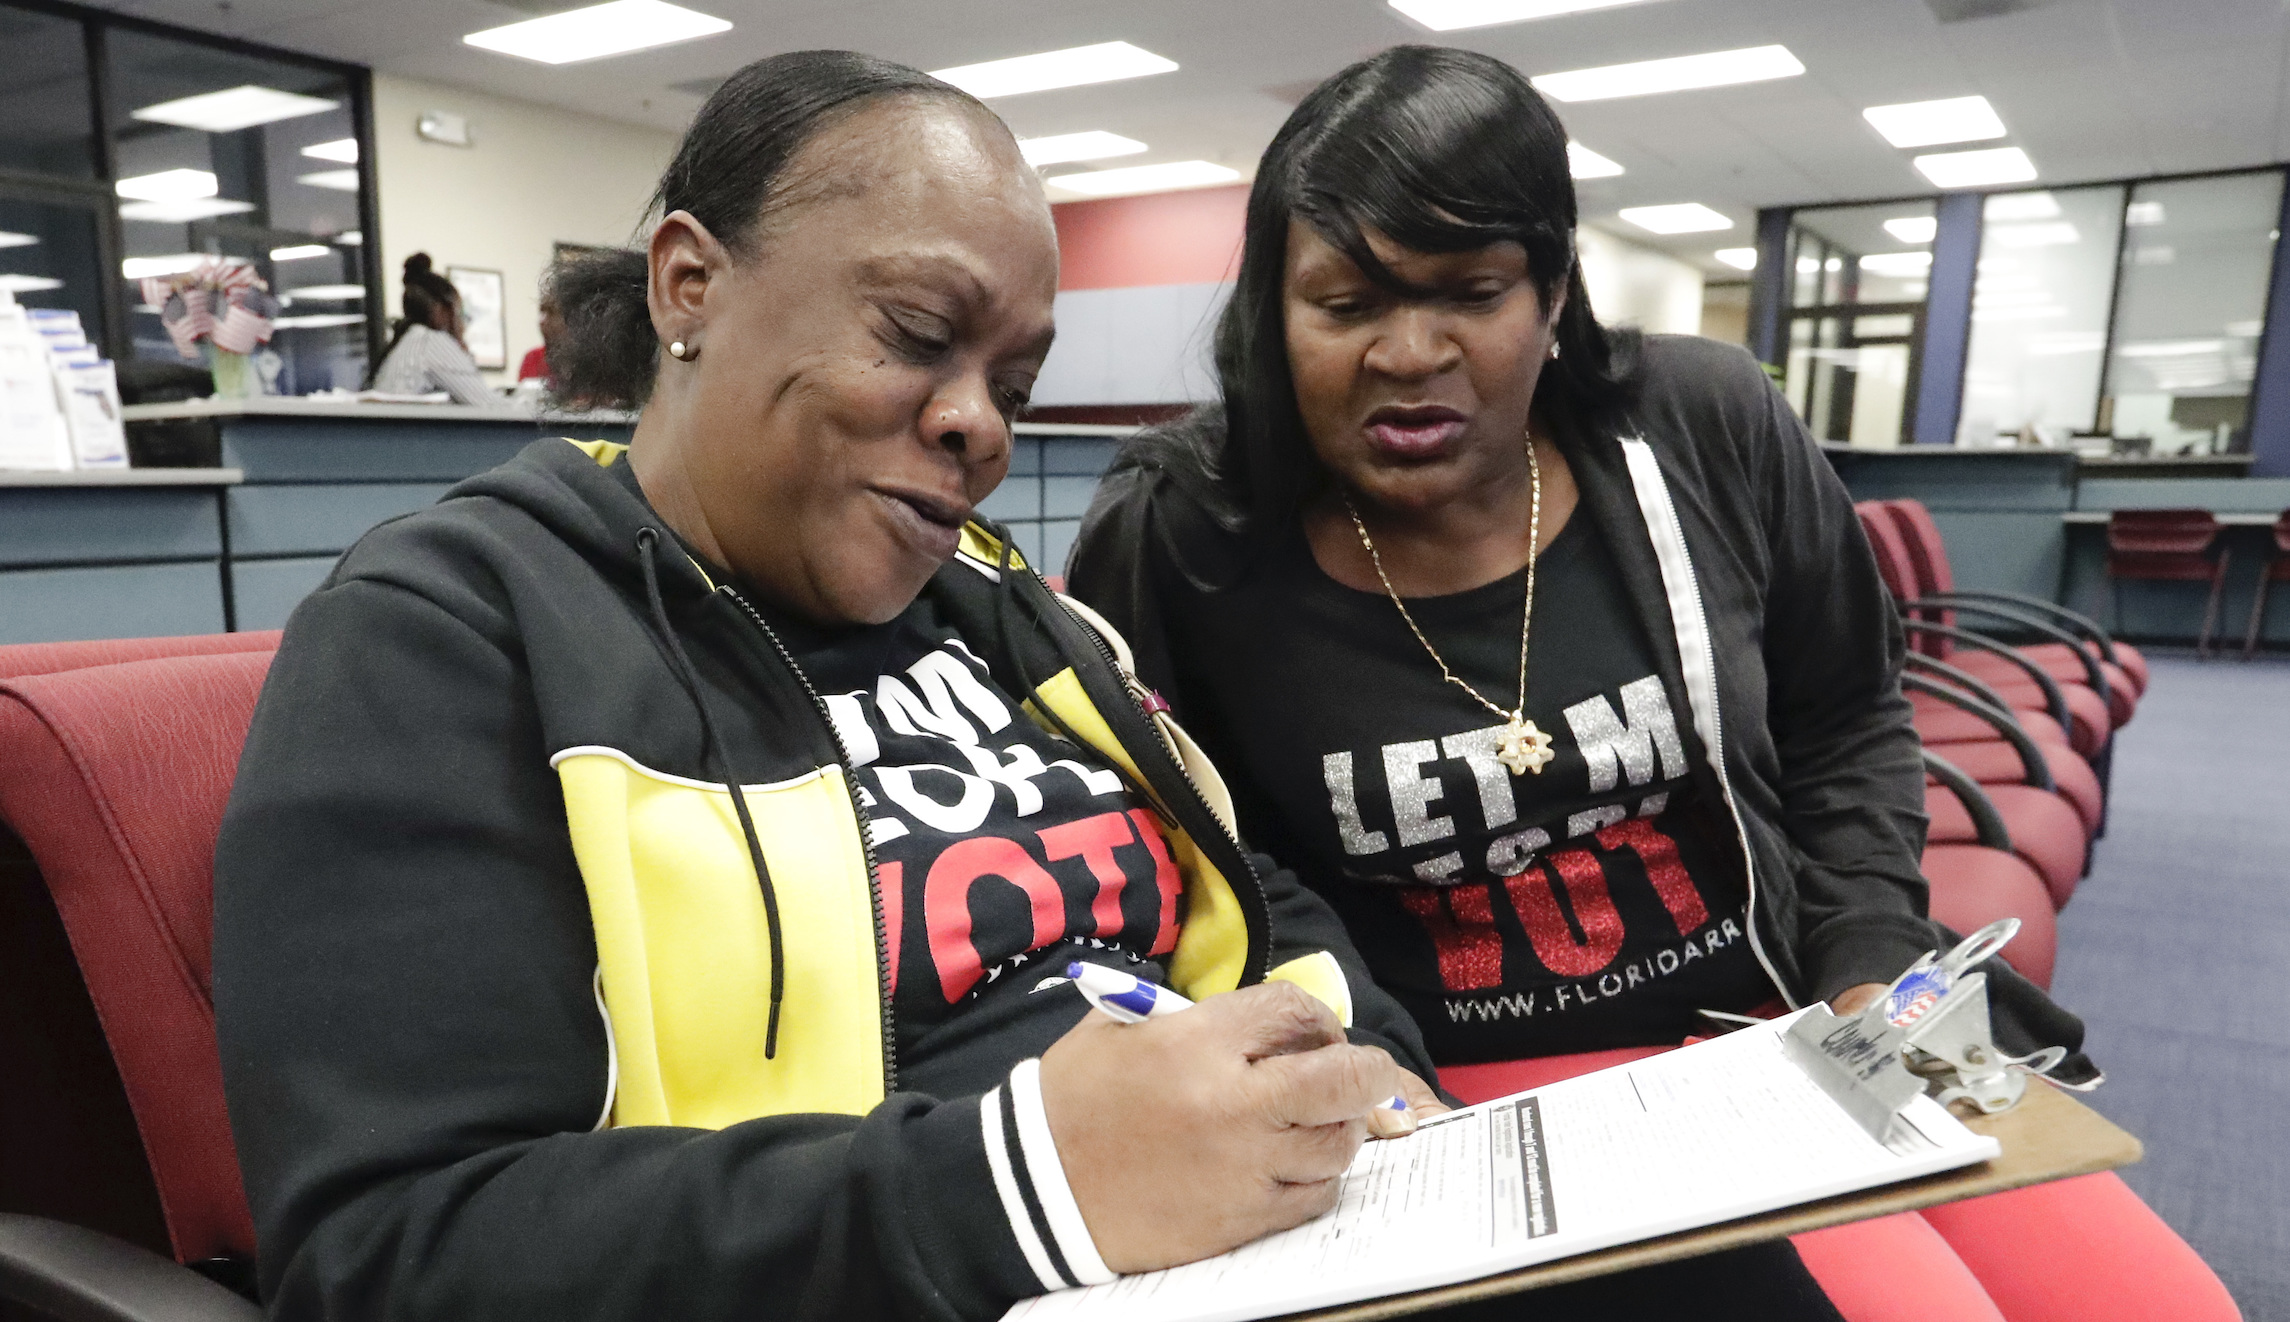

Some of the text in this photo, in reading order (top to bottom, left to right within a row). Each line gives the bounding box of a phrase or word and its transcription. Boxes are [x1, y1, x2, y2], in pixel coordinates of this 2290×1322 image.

[1323, 722, 1518, 857] LET
[1562, 673, 1690, 794] M
[1444, 904, 1746, 1024] WWW.FLORIDARR
